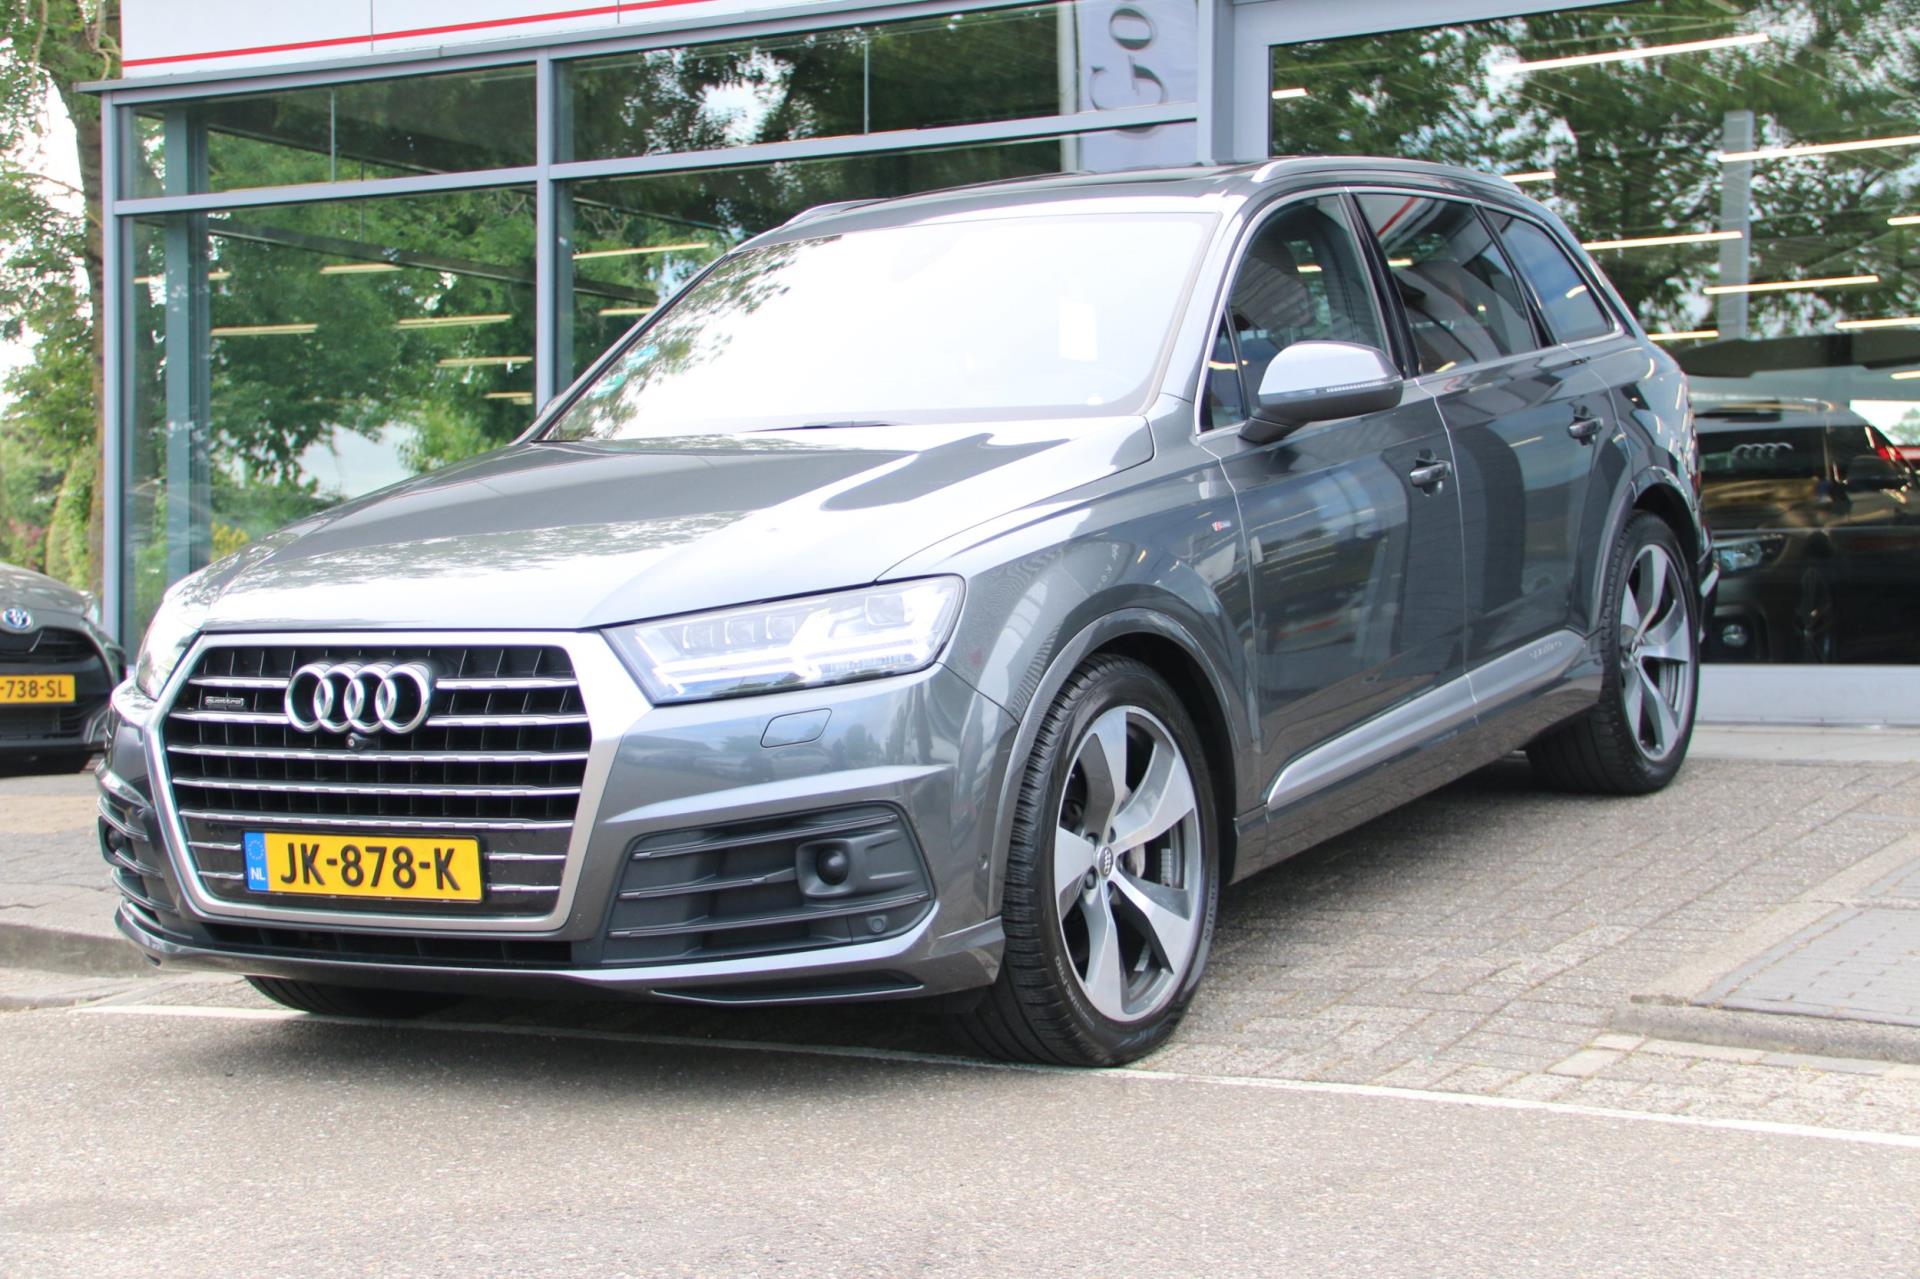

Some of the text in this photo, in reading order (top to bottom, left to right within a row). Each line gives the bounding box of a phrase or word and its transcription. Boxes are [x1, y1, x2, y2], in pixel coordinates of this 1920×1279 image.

[0, 680, 67, 698] -738-SL
[250, 867, 266, 881] NL
[280, 842, 461, 891] JK-878-K
